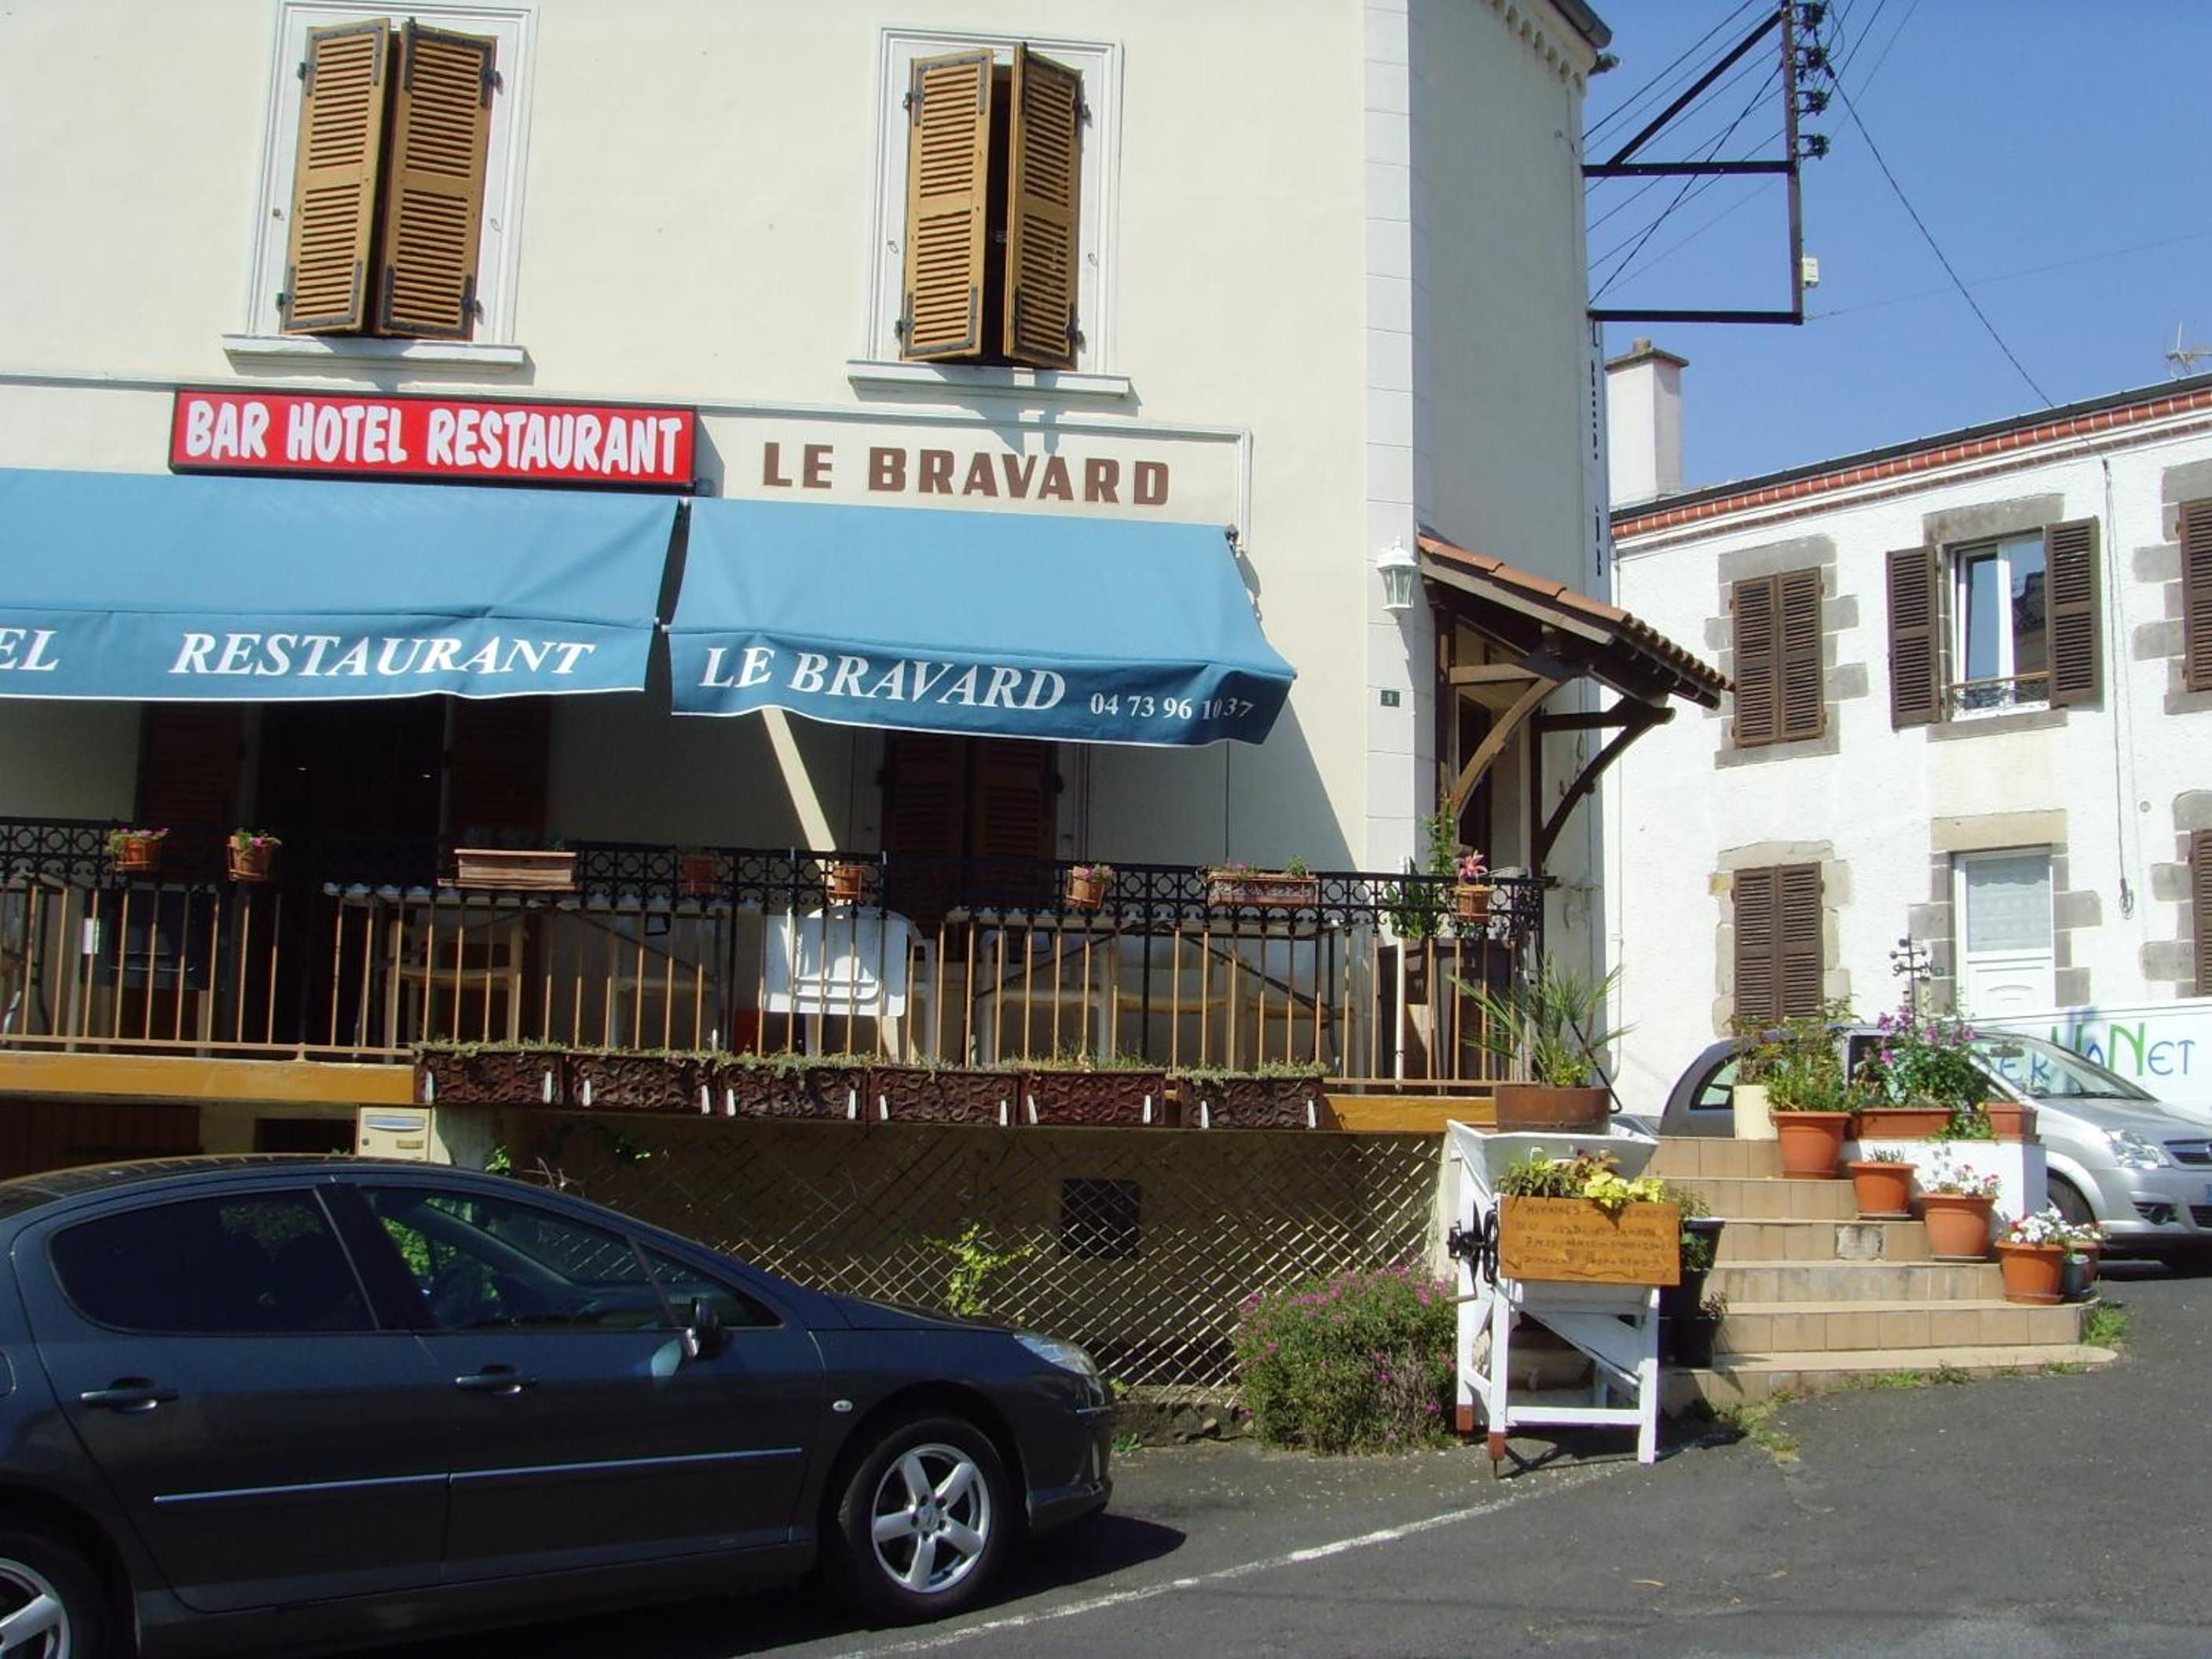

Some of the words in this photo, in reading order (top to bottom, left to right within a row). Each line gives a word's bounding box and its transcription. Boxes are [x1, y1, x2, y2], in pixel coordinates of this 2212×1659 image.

[185, 399, 271, 461] BAR
[286, 402, 408, 464] HOTEL
[427, 408, 684, 475] RESTAURANT
[763, 442, 834, 489] LE
[868, 447, 1170, 506] BRAVARD
[167, 632, 596, 677] RESTAURANT
[698, 646, 776, 689] LE
[788, 650, 1066, 712] BRAVARD
[1090, 692, 1119, 716] 04
[1126, 695, 1156, 718] 73
[1163, 697, 1194, 720] 96
